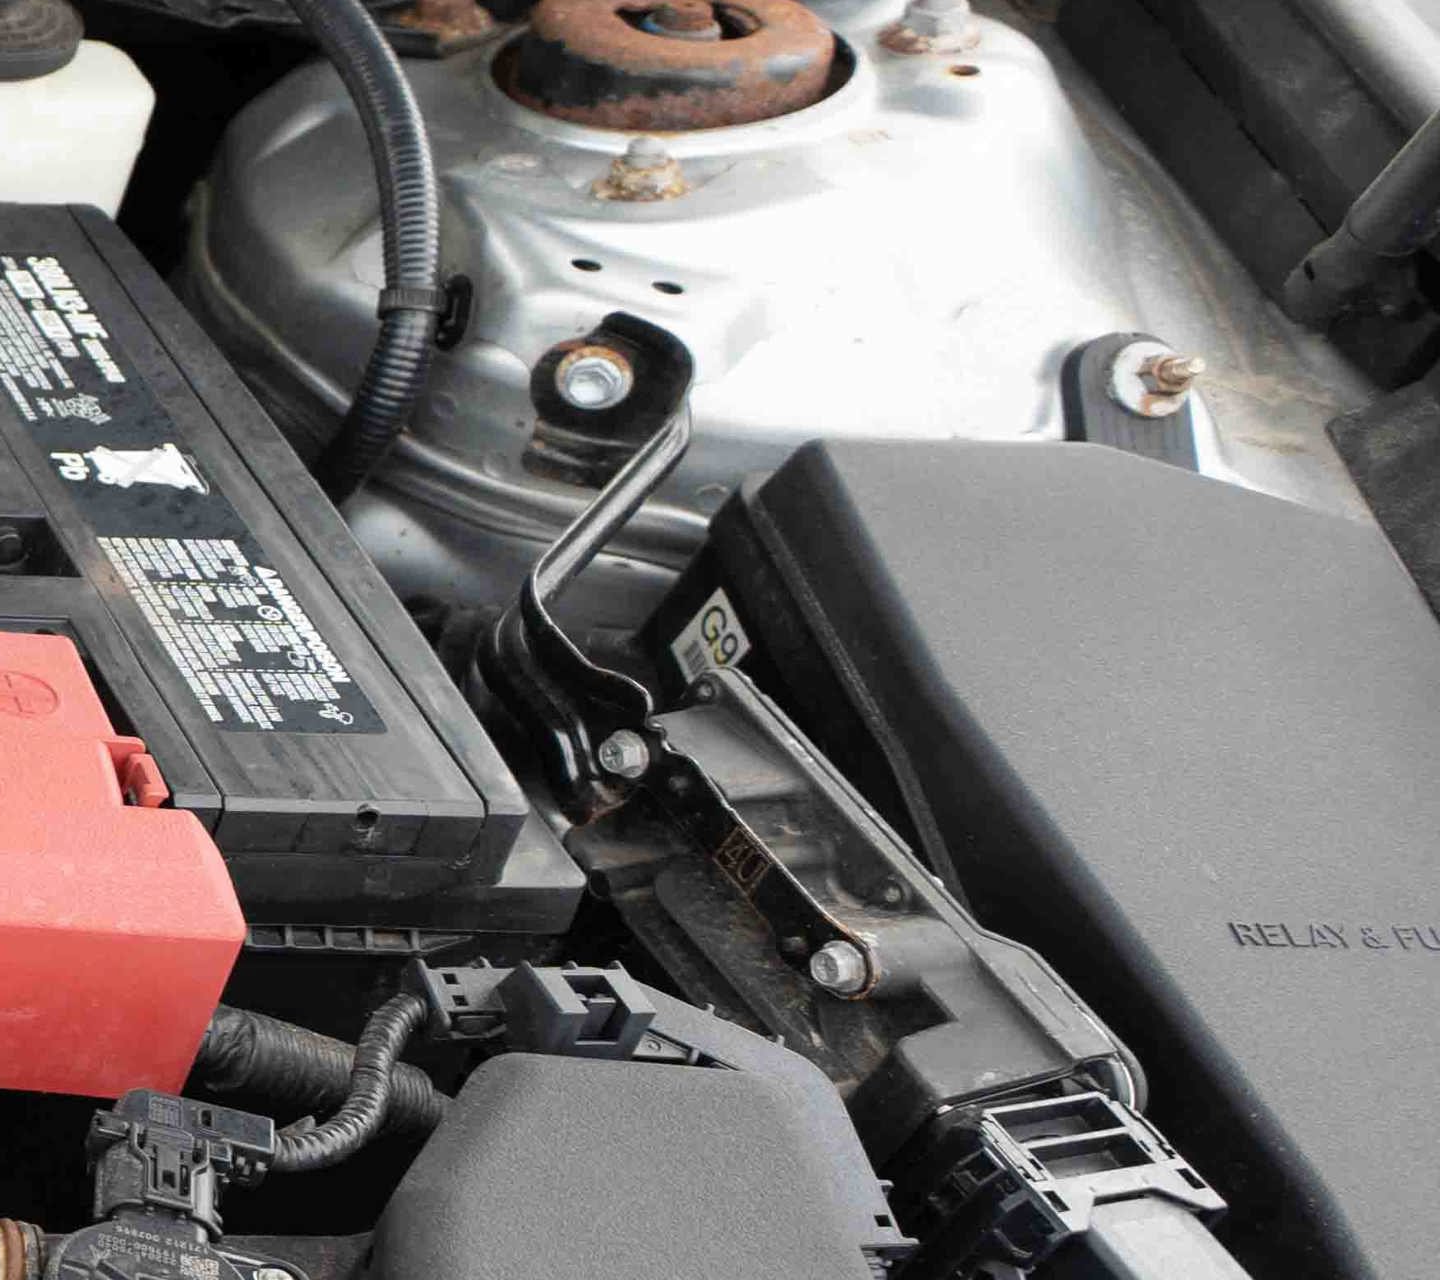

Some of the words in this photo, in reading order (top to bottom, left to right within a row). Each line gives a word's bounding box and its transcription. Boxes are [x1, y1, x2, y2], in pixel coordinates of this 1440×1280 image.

[49, 451, 91, 481] Pb
[699, 603, 740, 666] G9
[1228, 923, 1350, 950] RELAY
[1360, 926, 1391, 949] &
